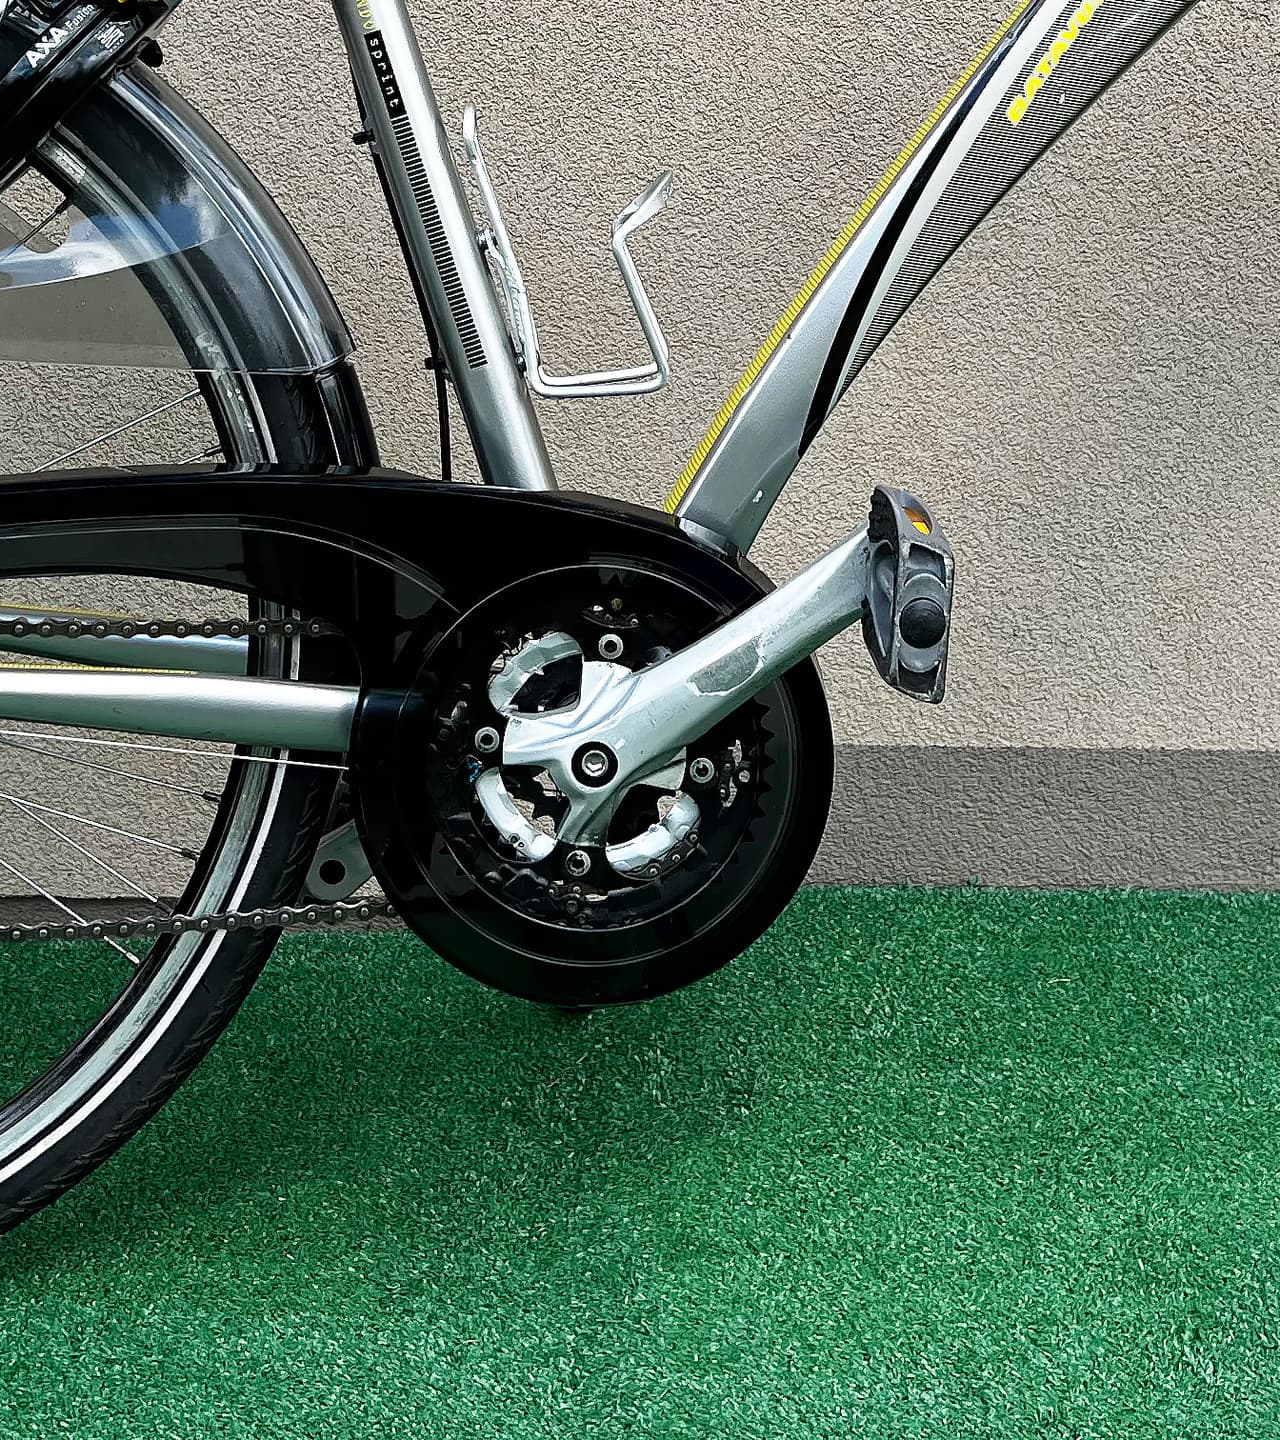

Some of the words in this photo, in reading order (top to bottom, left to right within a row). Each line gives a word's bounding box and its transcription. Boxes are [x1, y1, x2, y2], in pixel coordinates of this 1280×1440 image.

[25, 27, 69, 68] AXA
[64, 4, 95, 30] Fusion
[369, 38, 400, 108] sprint
